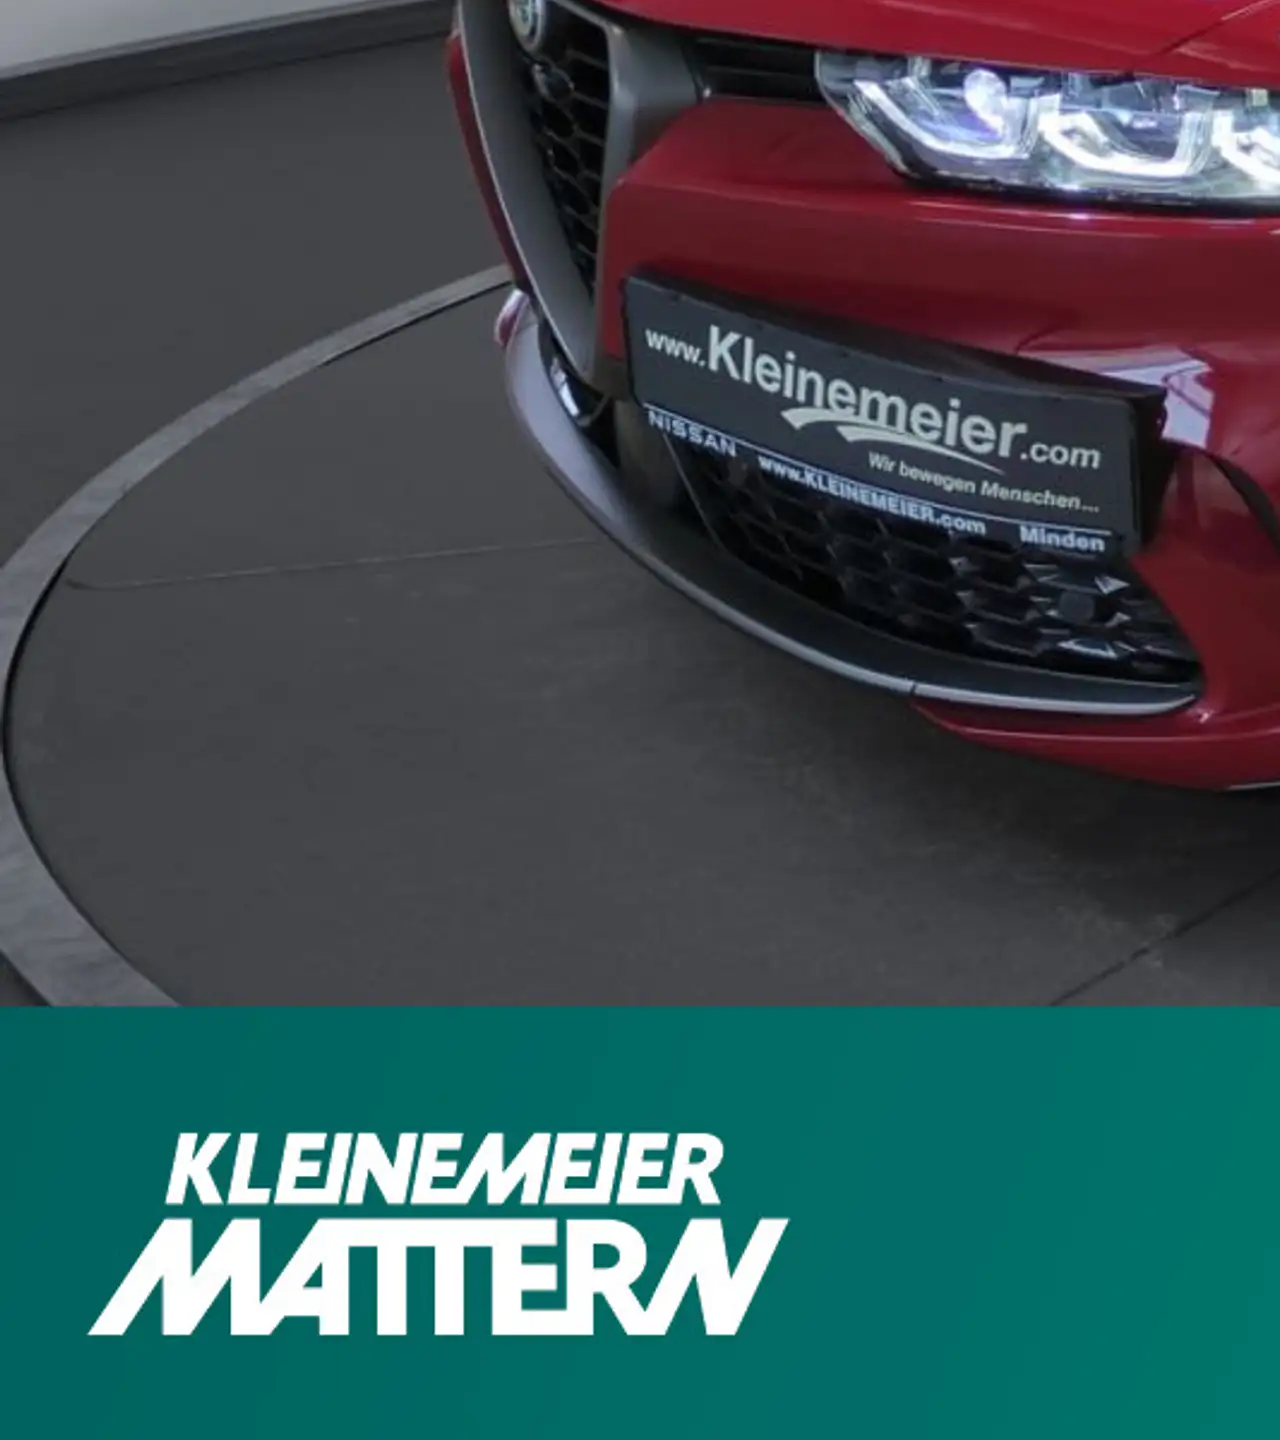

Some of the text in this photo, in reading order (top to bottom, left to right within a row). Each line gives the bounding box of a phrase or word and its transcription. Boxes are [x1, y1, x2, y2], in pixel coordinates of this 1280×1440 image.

[644, 323, 1101, 470] www.Kleinemeier.com
[647, 409, 1106, 553] NISSAN www.KLEINEMEIER.com Minden
[867, 450, 897, 474] Wir
[899, 462, 976, 495] bewegen
